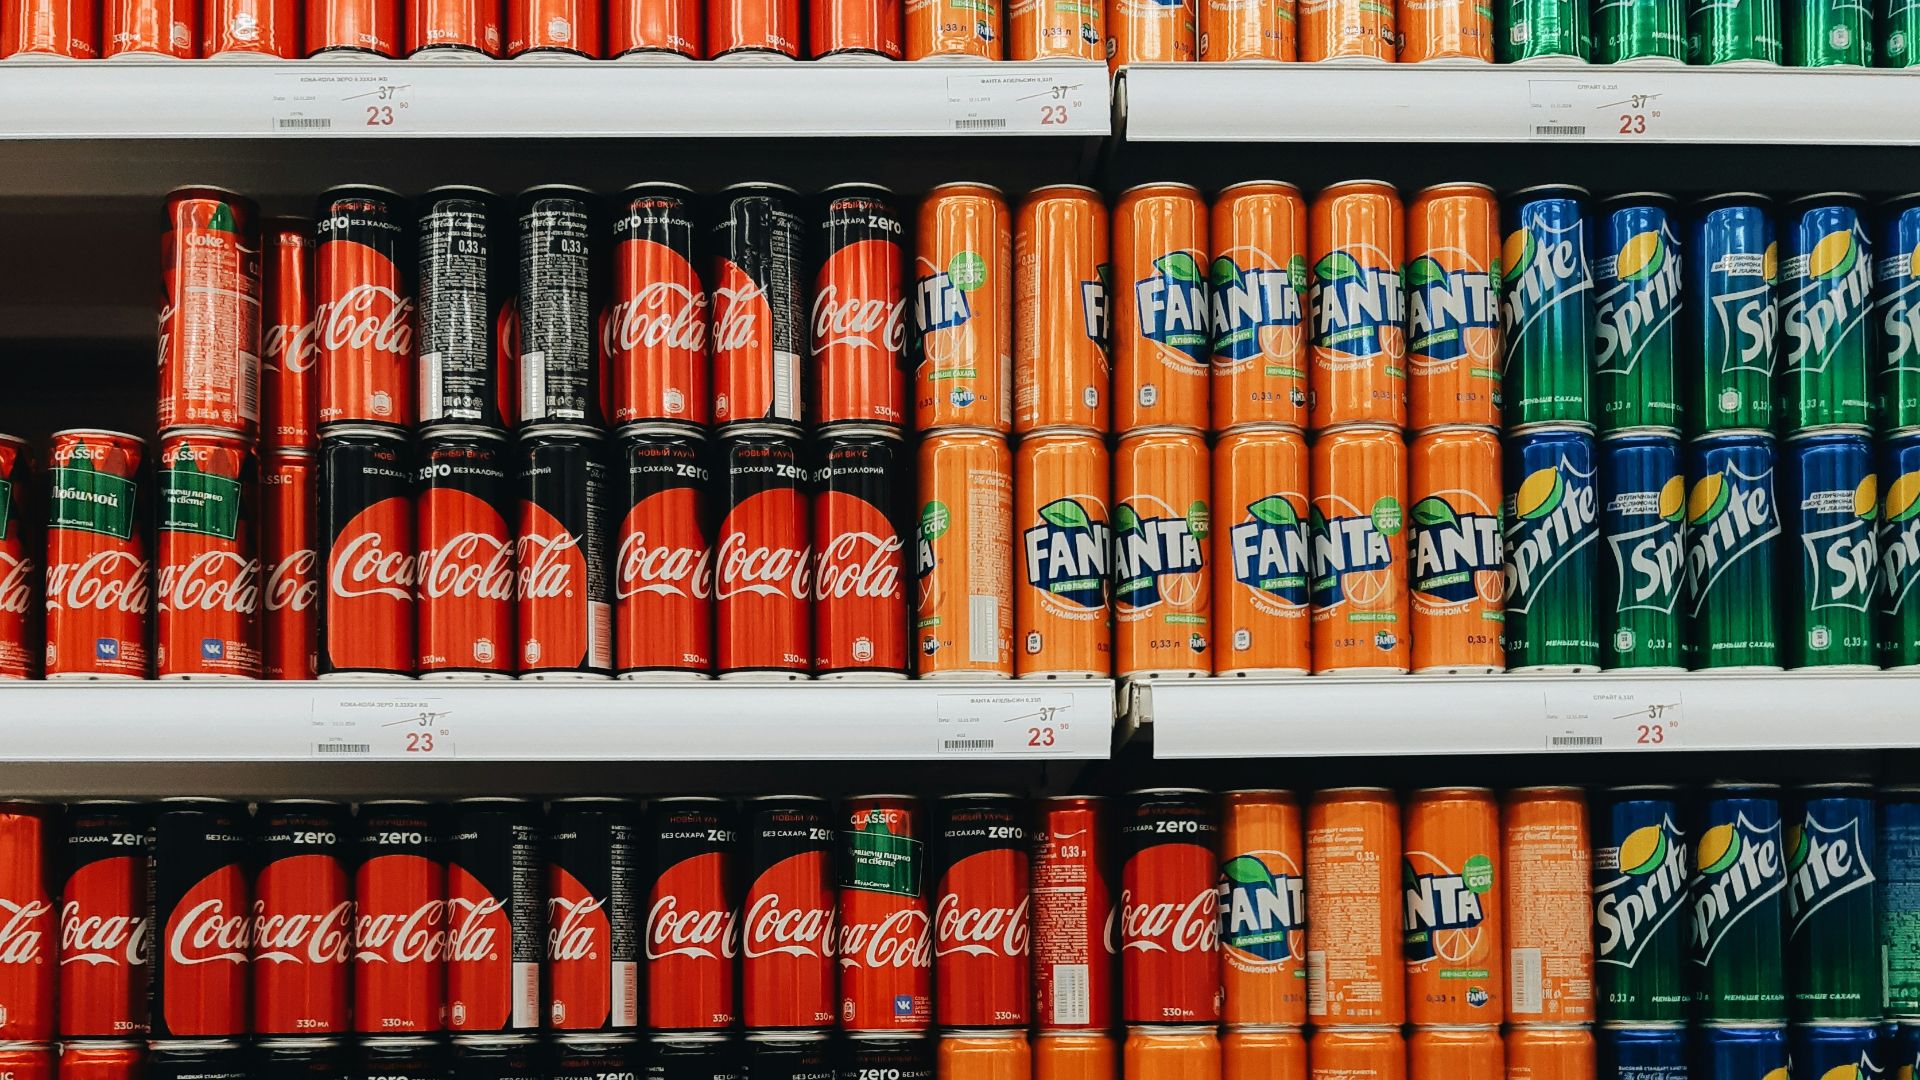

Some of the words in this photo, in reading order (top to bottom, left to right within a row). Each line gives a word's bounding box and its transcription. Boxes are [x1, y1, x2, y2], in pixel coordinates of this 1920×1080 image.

[378, 86, 395, 100] 37
[1052, 86, 1068, 100] 37
[1631, 95, 1647, 109] 37
[366, 106, 394, 126] 23
[1041, 105, 1068, 125] 23
[1619, 115, 1646, 134] 23
[317, 215, 349, 234] zero
[351, 219, 367, 227] БЕЗ
[613, 216, 641, 235] zero
[836, 217, 865, 226] САХАРА
[869, 215, 901, 234] zero
[458, 240, 478, 254] 0,33
[561, 240, 581, 254] 0,33
[1597, 245, 1683, 366] Sprite
[1252, 392, 1272, 401] 0,33
[1554, 395, 1582, 403] САХАРА
[874, 405, 890, 415] 330
[1606, 400, 1623, 412] 0,33
[54, 450, 104, 462] CLASSIC
[162, 450, 207, 463] CLASSIC
[638, 448, 670, 457] НОВЫЙ
[739, 448, 769, 457] НОВЫЙ
[363, 467, 378, 475] БЕЗ
[419, 463, 450, 480] zero
[629, 466, 641, 474] БЕЗ
[643, 465, 674, 473] САХАРА
[676, 463, 709, 481] zero
[730, 467, 742, 475] БЕЗ
[743, 465, 774, 473] САХАРА
[776, 463, 808, 481] zero
[848, 466, 884, 475] КАЛОРИЙ
[52, 485, 118, 508] Любимой
[176, 496, 204, 507] свете
[192, 490, 223, 502] парню
[1812, 492, 1853, 500] ОТЛИЧНЫЙ
[924, 521, 947, 534] СОК
[1379, 518, 1400, 528] СОК
[1504, 479, 1596, 602] Sprite
[1054, 581, 1097, 593] Апельсин
[1421, 574, 1466, 590] Апельсин
[1150, 639, 1171, 649] 0,33
[1467, 636, 1487, 645] 0,33
[1546, 639, 1579, 647] МЕНЬШЕ
[1648, 639, 1665, 649] 0,33
[1712, 641, 1747, 649] МЕНЬШЕ
[1749, 641, 1775, 649] САХАРА
[1844, 637, 1860, 647] 0,33
[683, 653, 699, 663] 330
[783, 653, 799, 663] 330
[1039, 707, 1056, 722] 37
[1648, 705, 1664, 719] 37
[419, 712, 436, 727] 37
[1028, 727, 1055, 747] 23
[1637, 725, 1664, 744] 23
[406, 732, 434, 752] 23
[850, 813, 898, 825] CLASSIC
[956, 829, 985, 837] САХАРА
[988, 826, 1022, 839] zero
[1156, 820, 1198, 833] zero
[79, 835, 108, 843] САХАРА
[293, 831, 336, 845] zero
[379, 831, 422, 844] zero
[884, 851, 911, 862] парню
[1061, 846, 1079, 858] 0,33
[1356, 852, 1375, 861] 0,33
[868, 857, 896, 867] свете
[1468, 877, 1491, 886] СОК
[1597, 838, 1687, 955] Sprite
[1691, 835, 1779, 948] prite
[1236, 933, 1281, 946] Апельсин
[1610, 993, 1626, 1003] 0,33
[1652, 995, 1681, 1003] МЕНЬШЕ
[1724, 993, 1760, 1001] МЕНЬШЕ
[712, 1013, 728, 1022] 330
[814, 1012, 828, 1021] 330
[994, 1011, 1012, 1020] 330
[1162, 1007, 1181, 1017] 330
[113, 1021, 134, 1030] 330
[296, 1019, 315, 1028] 330
[382, 1018, 400, 1027] 330
